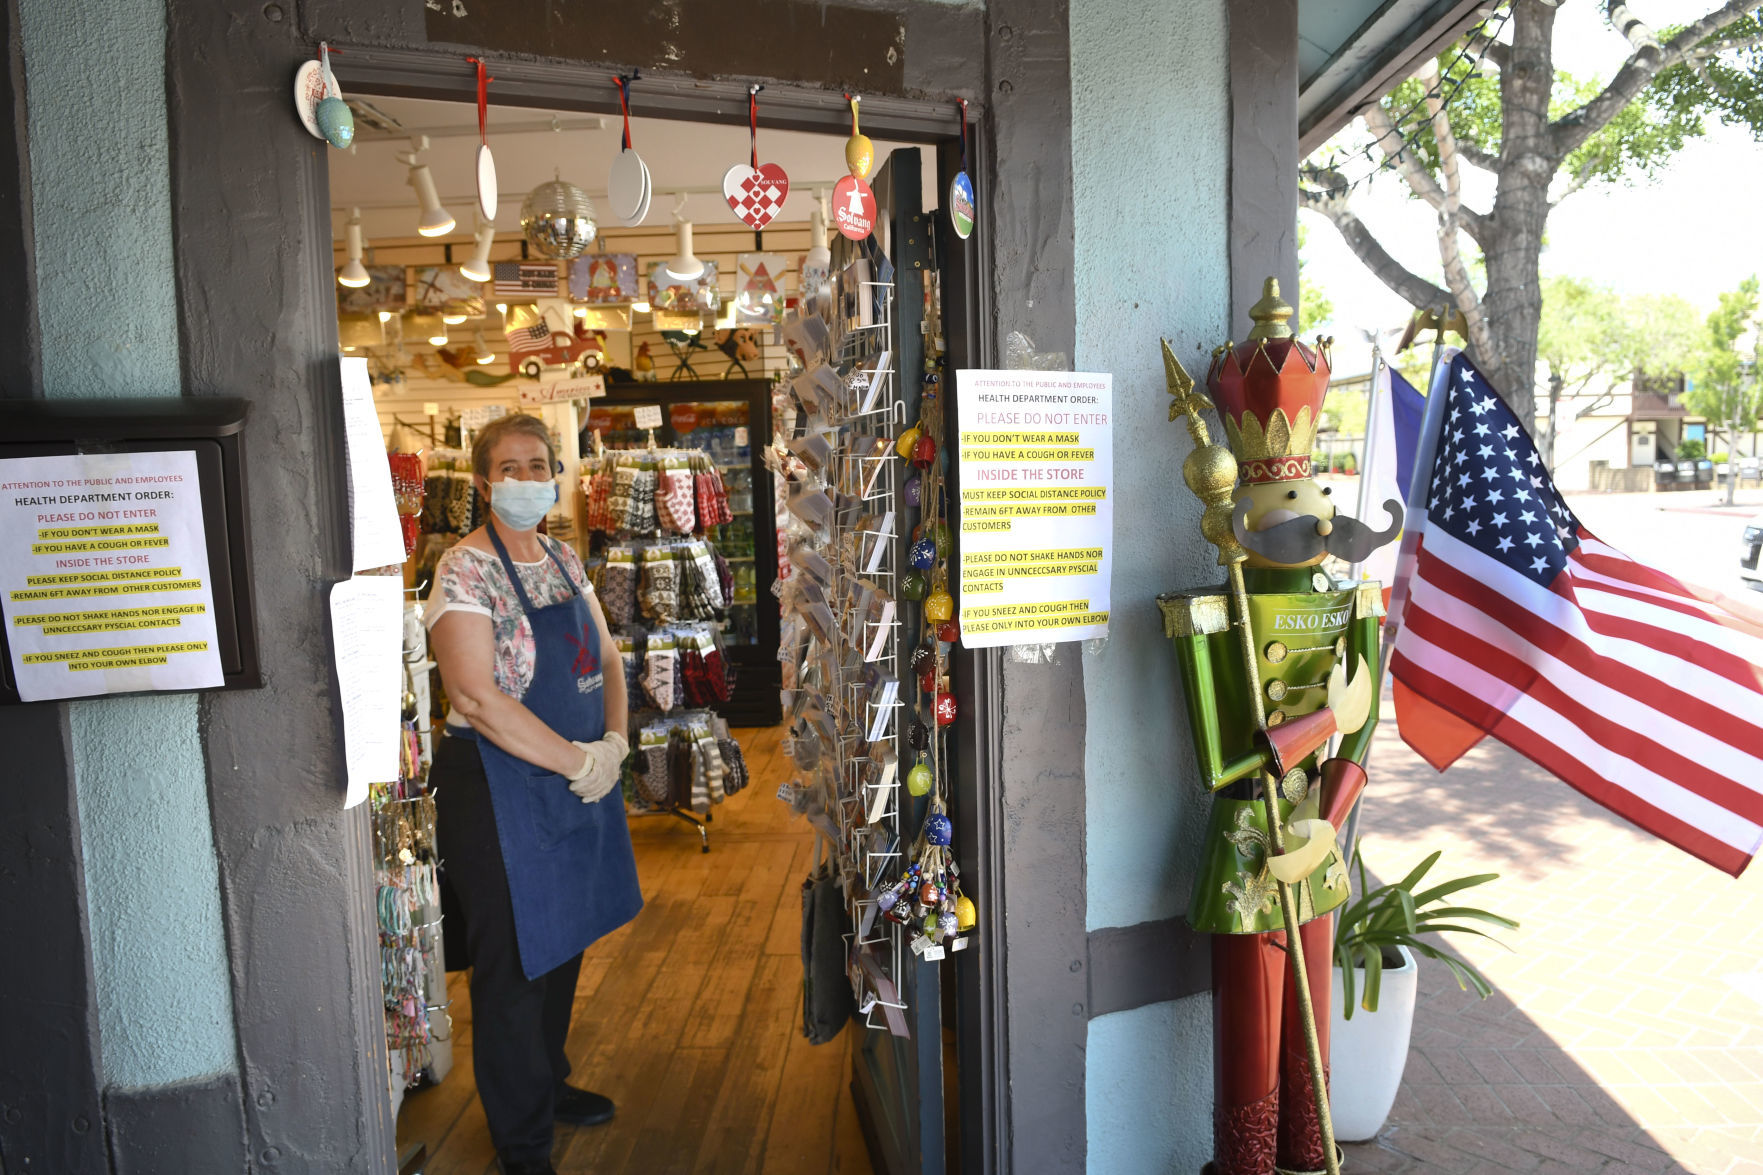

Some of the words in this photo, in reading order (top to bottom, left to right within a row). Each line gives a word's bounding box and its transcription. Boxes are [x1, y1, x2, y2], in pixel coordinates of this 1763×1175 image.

[838, 206, 870, 230] Solvang
[978, 394, 1010, 402] HEALTH
[1012, 394, 1068, 404] DEPARTMENT
[1070, 396, 1098, 404] ORDER:
[978, 412, 1020, 424] PLEASE
[1024, 412, 1042, 424] DO
[1045, 413, 1070, 424] NOT
[1074, 413, 1108, 425] ENTER
[973, 434, 990, 442] YOU
[992, 434, 1020, 442] DON'T
[1022, 434, 1046, 442] WEAR
[1048, 434, 1054, 442] A
[1056, 434, 1080, 442] MASK
[973, 450, 990, 459] YOU
[992, 450, 1016, 458] HAVE
[1018, 450, 1024, 458] A
[1026, 450, 1054, 458] COUGH
[1057, 450, 1068, 458] OR
[1072, 450, 1094, 458] FEVER
[978, 469, 1018, 480] INSIDE
[1022, 468, 1044, 480] THE
[1046, 468, 1084, 480] STORE
[1, 481, 50, 490] ATTENTION
[84, 478, 112, 486] PUBLIC
[136, 475, 183, 484] EMPLOYEES
[15, 496, 56, 506] HEALTH
[60, 492, 132, 504] DEPARTMENT
[135, 490, 174, 500] ORDER:
[962, 492, 984, 500] MUST
[986, 491, 1006, 499] KEEP
[1009, 490, 1038, 498] SOCIAL
[1040, 490, 1078, 498] DISTANCE
[1080, 489, 1106, 498] POLICY
[38, 513, 76, 522] PLEASE
[79, 512, 94, 520] DO
[98, 510, 120, 520] NOT
[124, 509, 157, 518] ENTER
[963, 508, 996, 516] -REMAIN
[1016, 506, 1041, 514] AWAY
[1043, 506, 1066, 514] FROM
[1072, 505, 1096, 513] OTHER
[72, 528, 98, 536] DON'T
[962, 522, 1012, 530] CUSTOMERS
[98, 542, 128, 550] COUGH
[56, 559, 90, 568] INSIDE
[94, 558, 114, 566] THE
[116, 554, 150, 564] STORE
[963, 554, 992, 563] -PLEASE
[994, 554, 1008, 562] DO
[1010, 553, 1028, 561] NOT
[1030, 552, 1054, 560] SHAKE
[1058, 551, 1084, 560] HANDS
[1086, 550, 1103, 558] NOR
[81, 574, 110, 582] SOCIAL
[112, 570, 151, 580] DISTANCE
[154, 568, 182, 576] POLICY
[962, 568, 994, 578] ENGAGE
[996, 568, 1006, 576] IN
[1008, 566, 1066, 576] UNNCECCSARY
[1068, 564, 1098, 573] PYSCIAL
[11, 592, 48, 600] -REMAIN
[94, 586, 118, 594] FROM
[122, 584, 150, 592] OTHER
[152, 581, 202, 590] CUSTOMERS
[962, 582, 1004, 592] CONTACTS
[14, 616, 46, 624] -PLEASE
[112, 610, 140, 618] HANDS
[162, 606, 194, 614] ENGAGE
[973, 609, 990, 618] YOU
[992, 607, 1016, 616] SNEEZ
[1018, 606, 1037, 614] AND
[1039, 604, 1068, 612] COUGH
[1070, 602, 1088, 610] THEN
[43, 624, 102, 634] UNNCECCSARY
[104, 621, 136, 630] PYSCIAL
[139, 618, 181, 628] CONTACTS
[962, 622, 990, 632] PLEASE
[992, 621, 1012, 630] ONLY
[1014, 620, 1034, 628] INTO
[1038, 618, 1058, 627] YOUR
[1061, 616, 1080, 625] OWN
[1083, 614, 1109, 624] ELBOW
[1274, 614, 1318, 630] ESKO
[1322, 610, 1348, 628] ESKO
[102, 648, 132, 656] COUGH
[157, 644, 184, 652] PLEASE
[68, 662, 88, 670] INTO
[91, 660, 114, 668] YOUR
